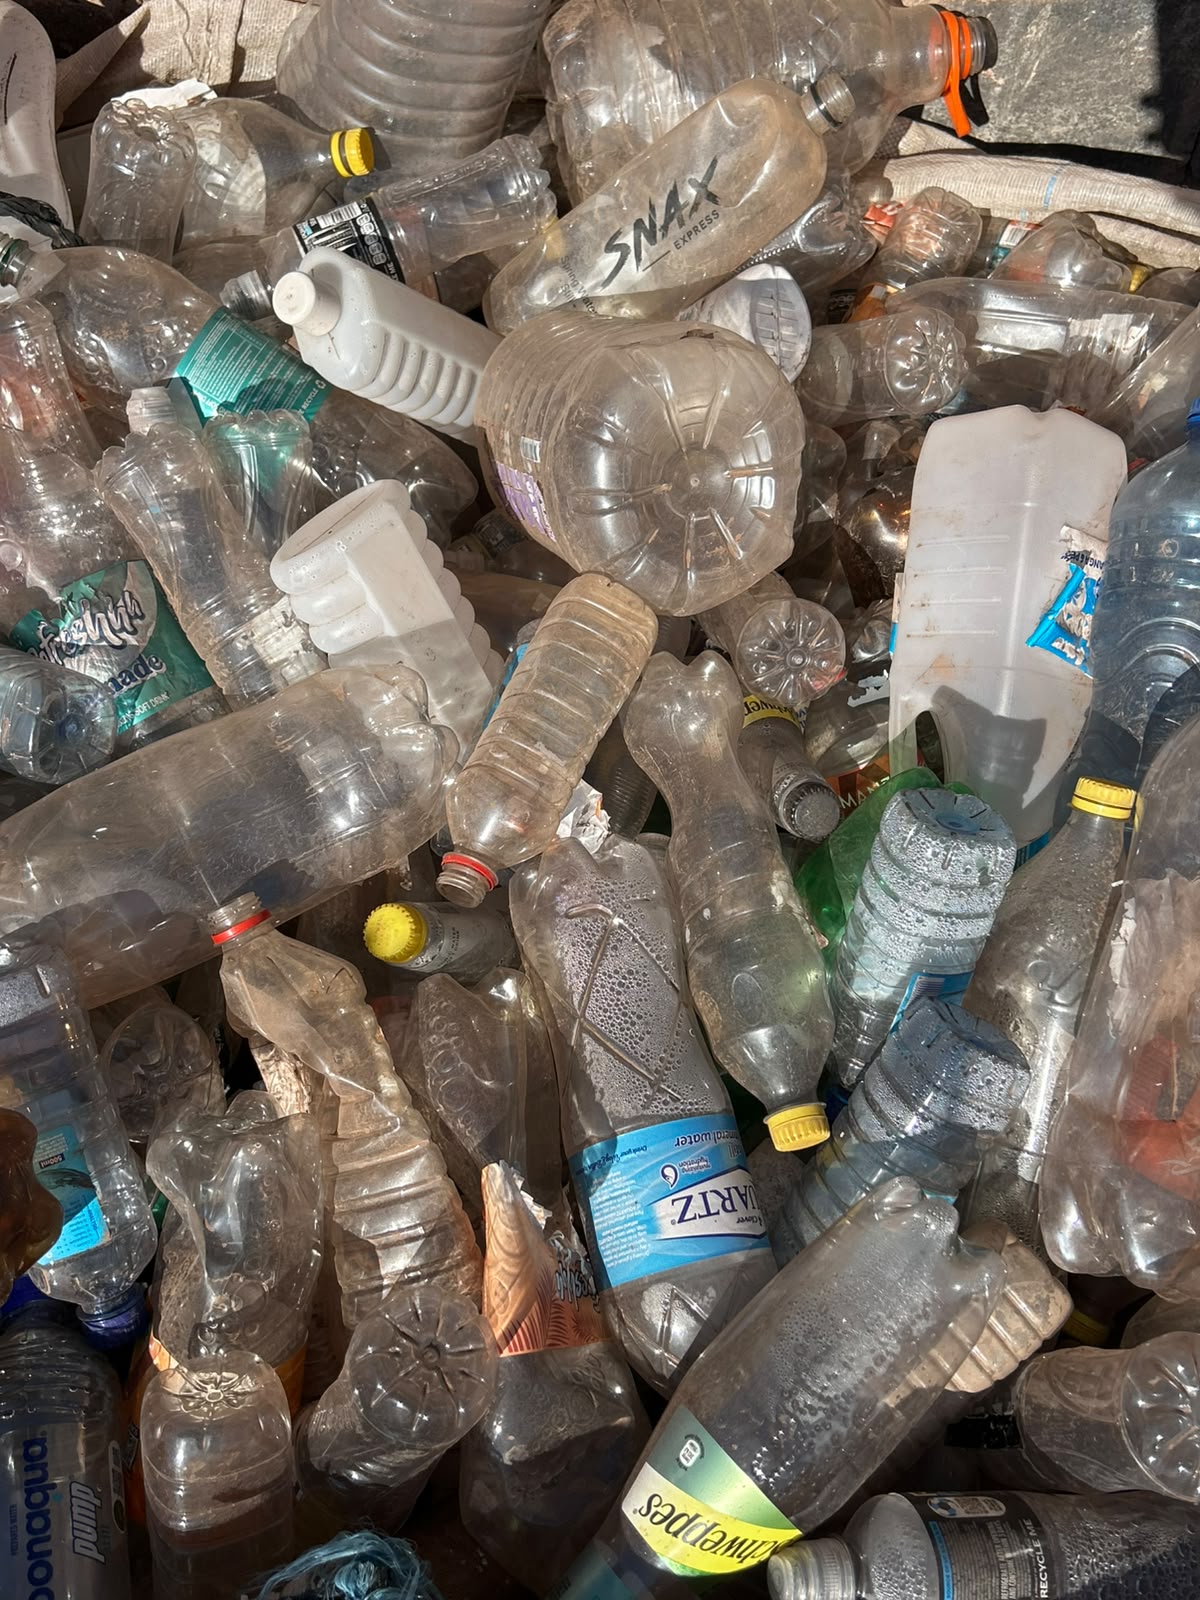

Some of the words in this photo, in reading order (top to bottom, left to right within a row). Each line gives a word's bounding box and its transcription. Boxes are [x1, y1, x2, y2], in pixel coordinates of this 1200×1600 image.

[600, 154, 720, 289] SNAX
[673, 209, 720, 250] EXPRESS
[560, 255, 580, 288] Spring
[134, 703, 152, 717] SOFT
[674, 1133, 712, 1148] water
[40, 1155, 63, 1168] 500ml
[677, 1156, 710, 1168] hydration
[736, 1215, 757, 1225] Clover
[8, 1503, 17, 1524] WATER
[69, 1480, 106, 1565] pump
[1023, 1518, 1038, 1536] ME
[1032, 1538, 1049, 1598] RECYCLE
